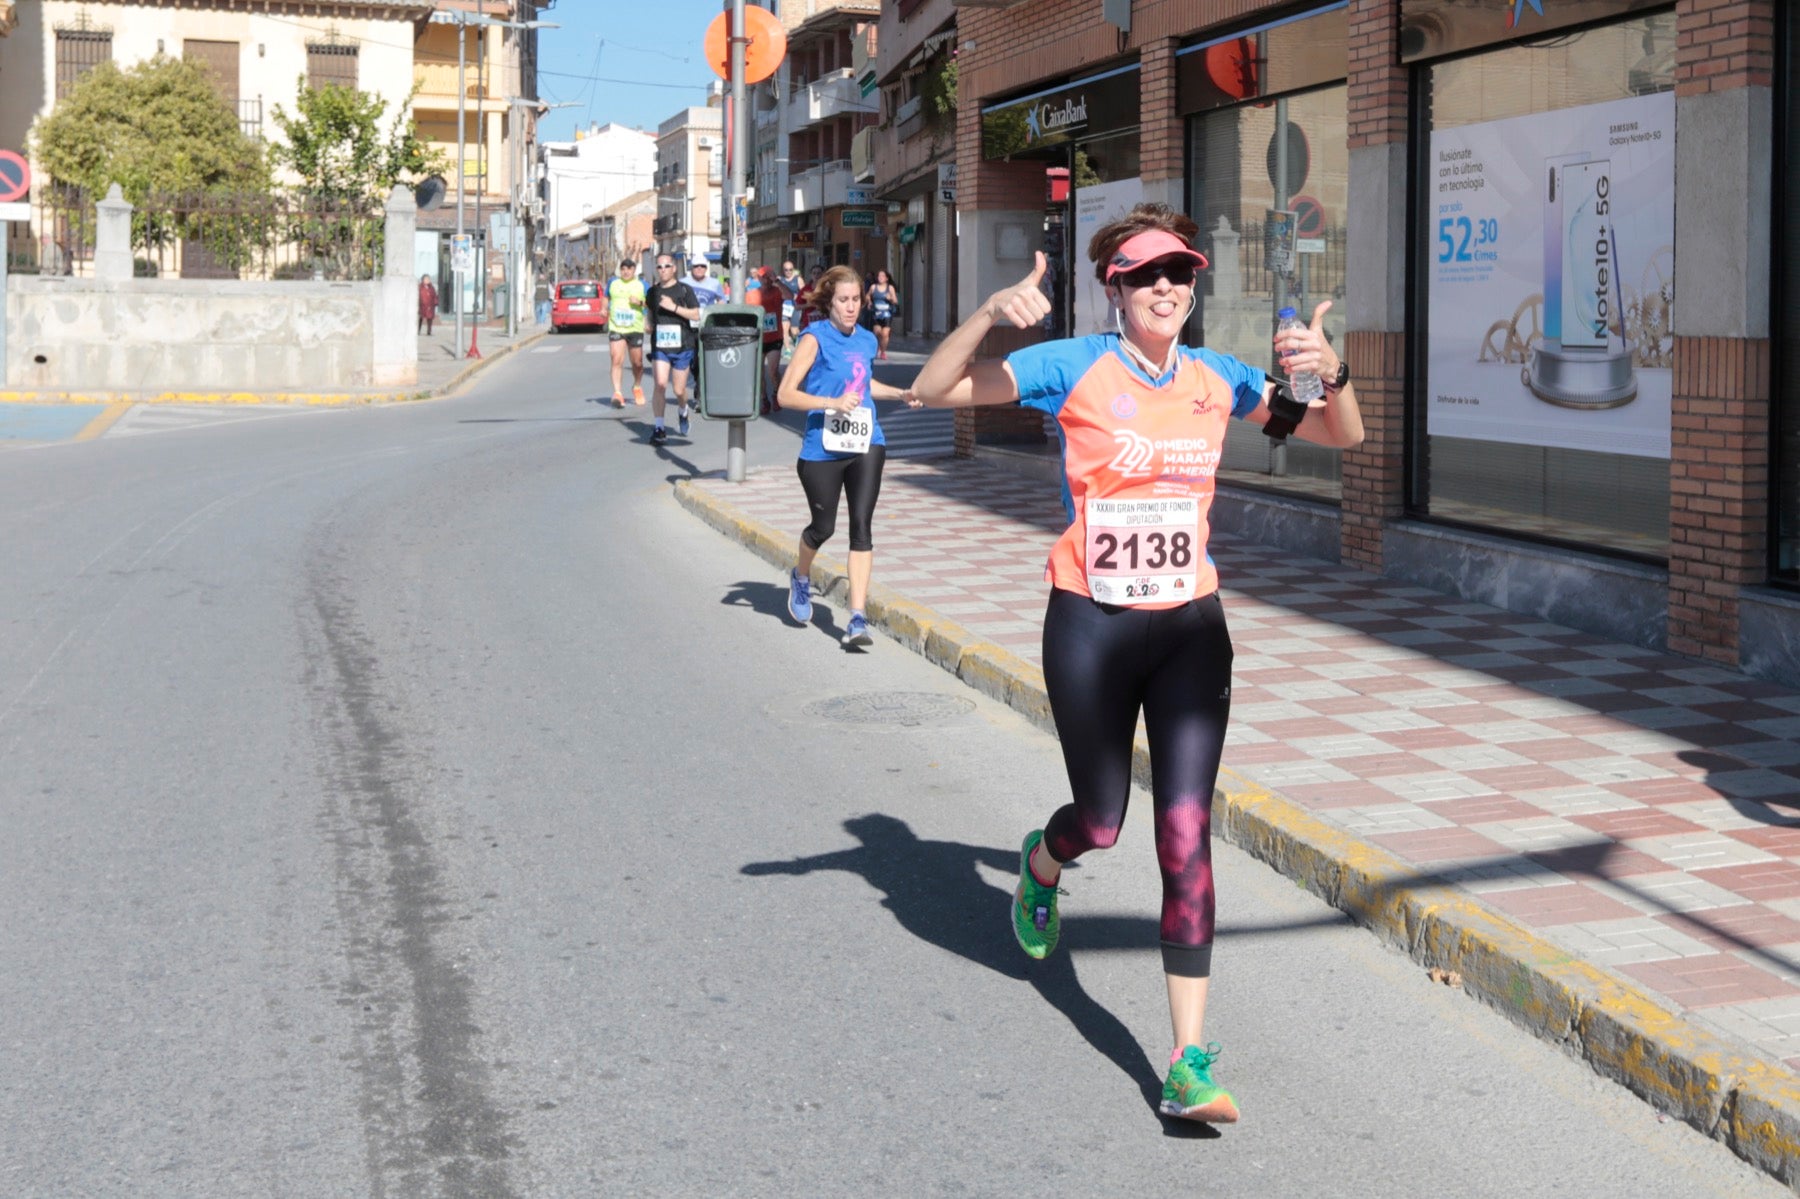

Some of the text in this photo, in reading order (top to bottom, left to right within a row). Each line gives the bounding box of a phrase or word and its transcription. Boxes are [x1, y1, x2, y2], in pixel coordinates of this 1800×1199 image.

[1042, 95, 1087, 129] CaixaBank
[1609, 121, 1638, 134] SAMSUNG
[1609, 136, 1630, 146] Galaxy
[1653, 130, 1661, 140] 5G
[1439, 149, 1472, 162] Ilusiónate
[1439, 162, 1483, 177] con lo último
[1439, 178, 1485, 192] en tecnología
[1595, 175, 1609, 339] Note10+ 5G
[659, 332, 677, 341] 474
[831, 418, 868, 437] 3088
[1164, 438, 1207, 450] MEDIO
[1117, 504, 1135, 513] GRAN
[1136, 503, 1159, 512] PREMIO
[1161, 502, 1168, 512] DE
[1170, 502, 1192, 511] FONDO
[1126, 514, 1163, 525] DIPUTACIÓN
[1094, 531, 1191, 570] 2138
